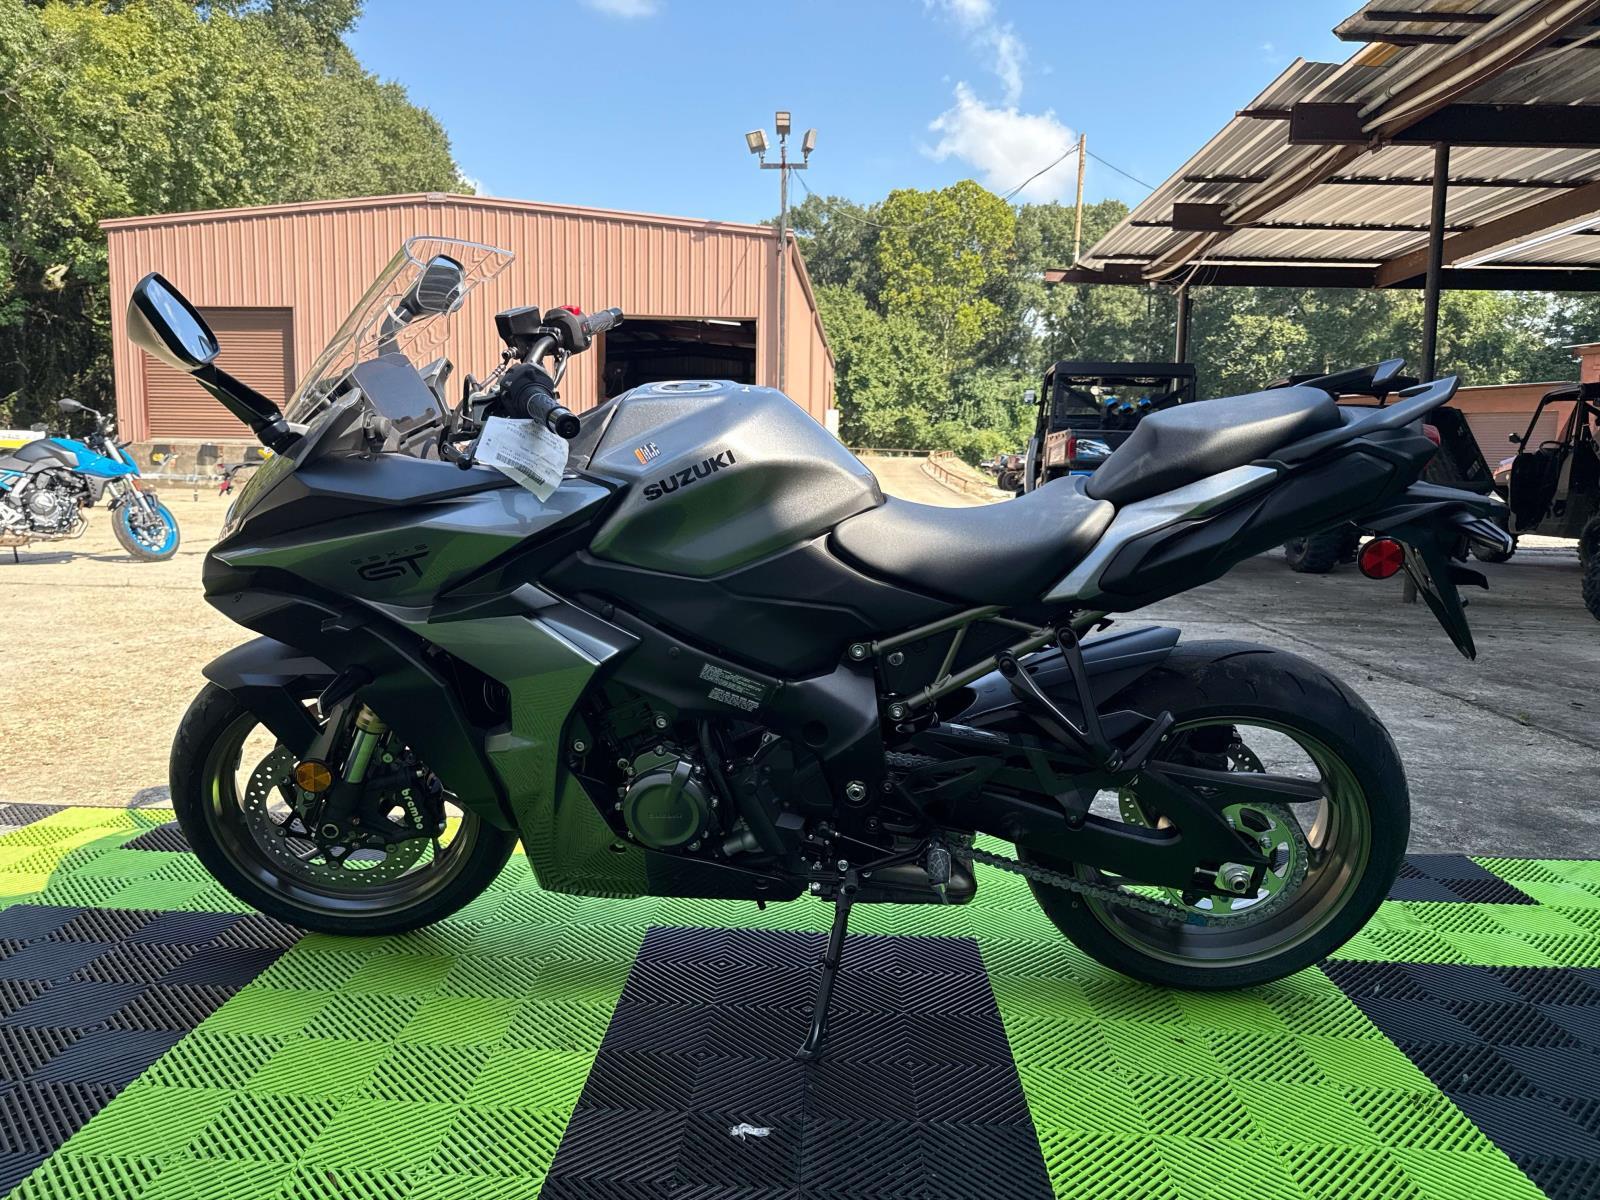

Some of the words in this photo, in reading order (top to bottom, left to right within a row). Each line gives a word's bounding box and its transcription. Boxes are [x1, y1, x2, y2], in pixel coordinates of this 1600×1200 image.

[642, 449, 736, 501] SUZUKI
[357, 550, 432, 582] GT
[401, 787, 424, 830] brembo
